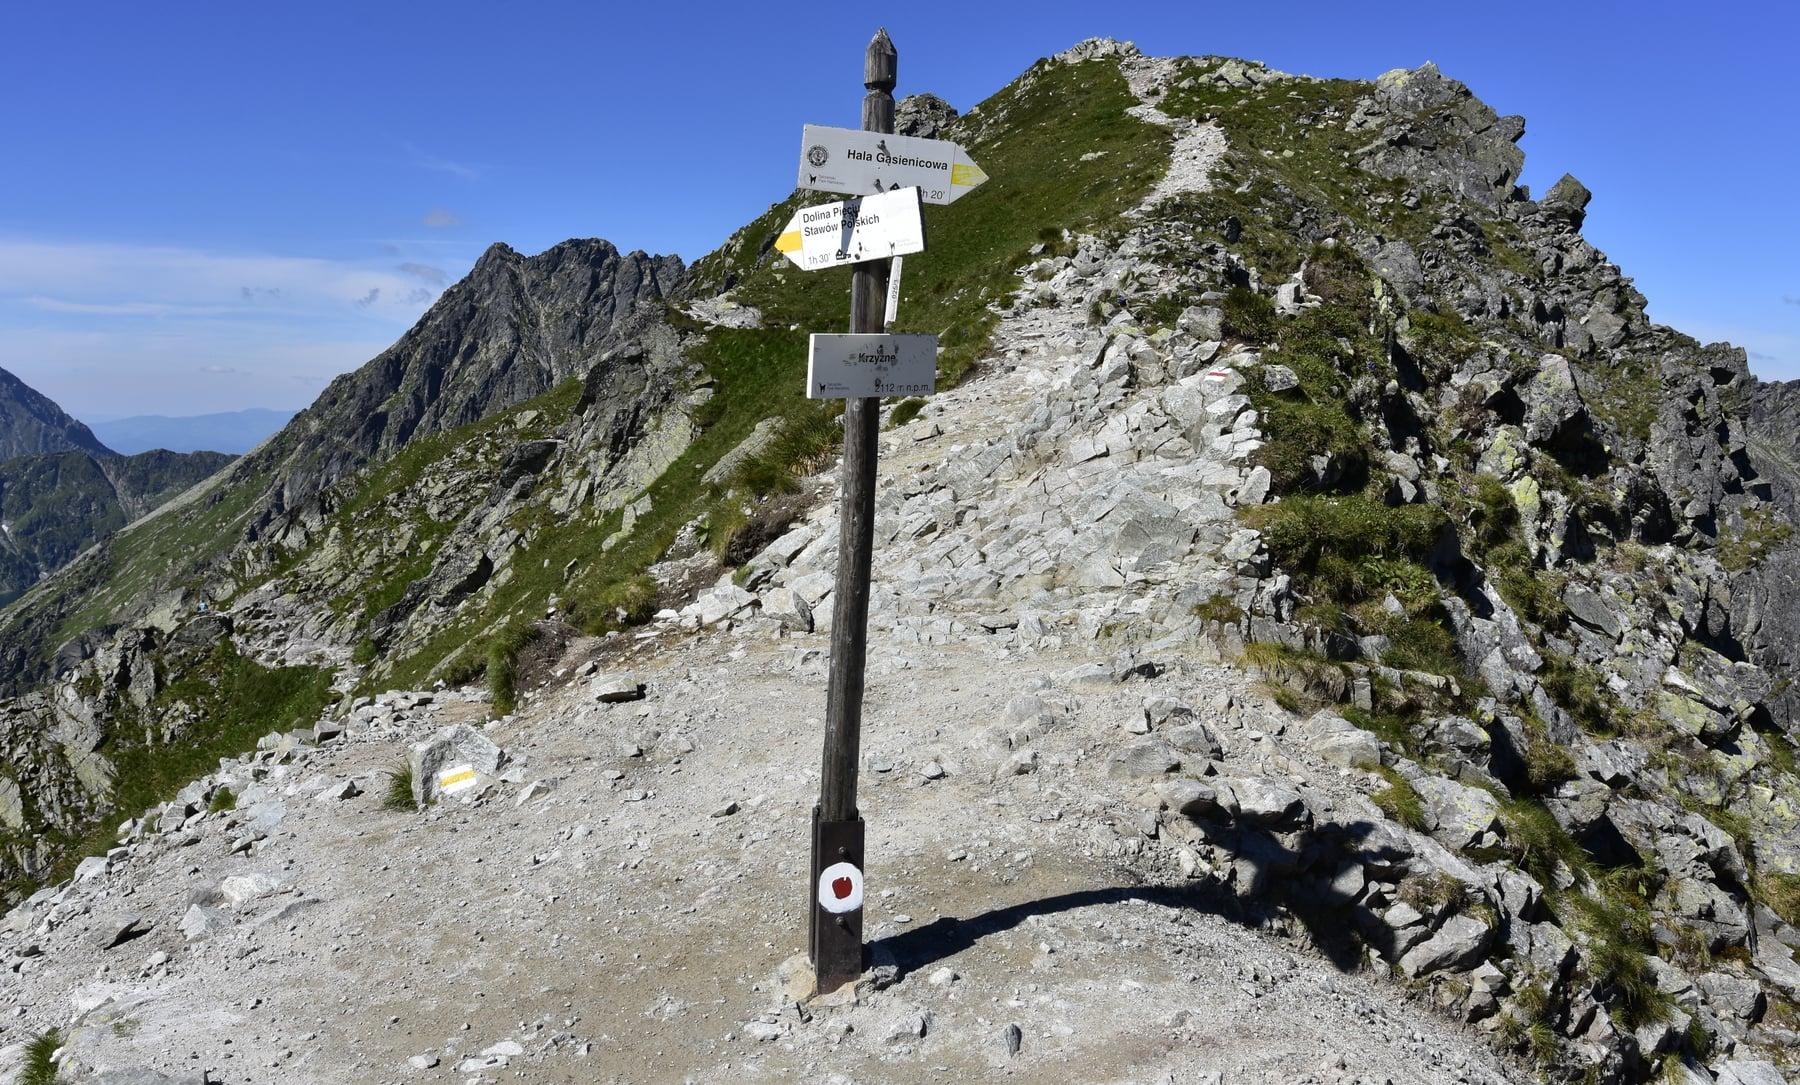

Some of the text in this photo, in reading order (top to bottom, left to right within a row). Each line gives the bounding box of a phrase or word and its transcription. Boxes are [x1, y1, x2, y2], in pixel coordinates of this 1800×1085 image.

[847, 149, 873, 162] Hala
[876, 152, 948, 171] Gąsienicowa
[803, 209, 830, 223] Dolina
[804, 214, 880, 236] Stawów Polskich
[874, 383, 895, 393] 2112
[906, 384, 931, 393] n.p.m.
